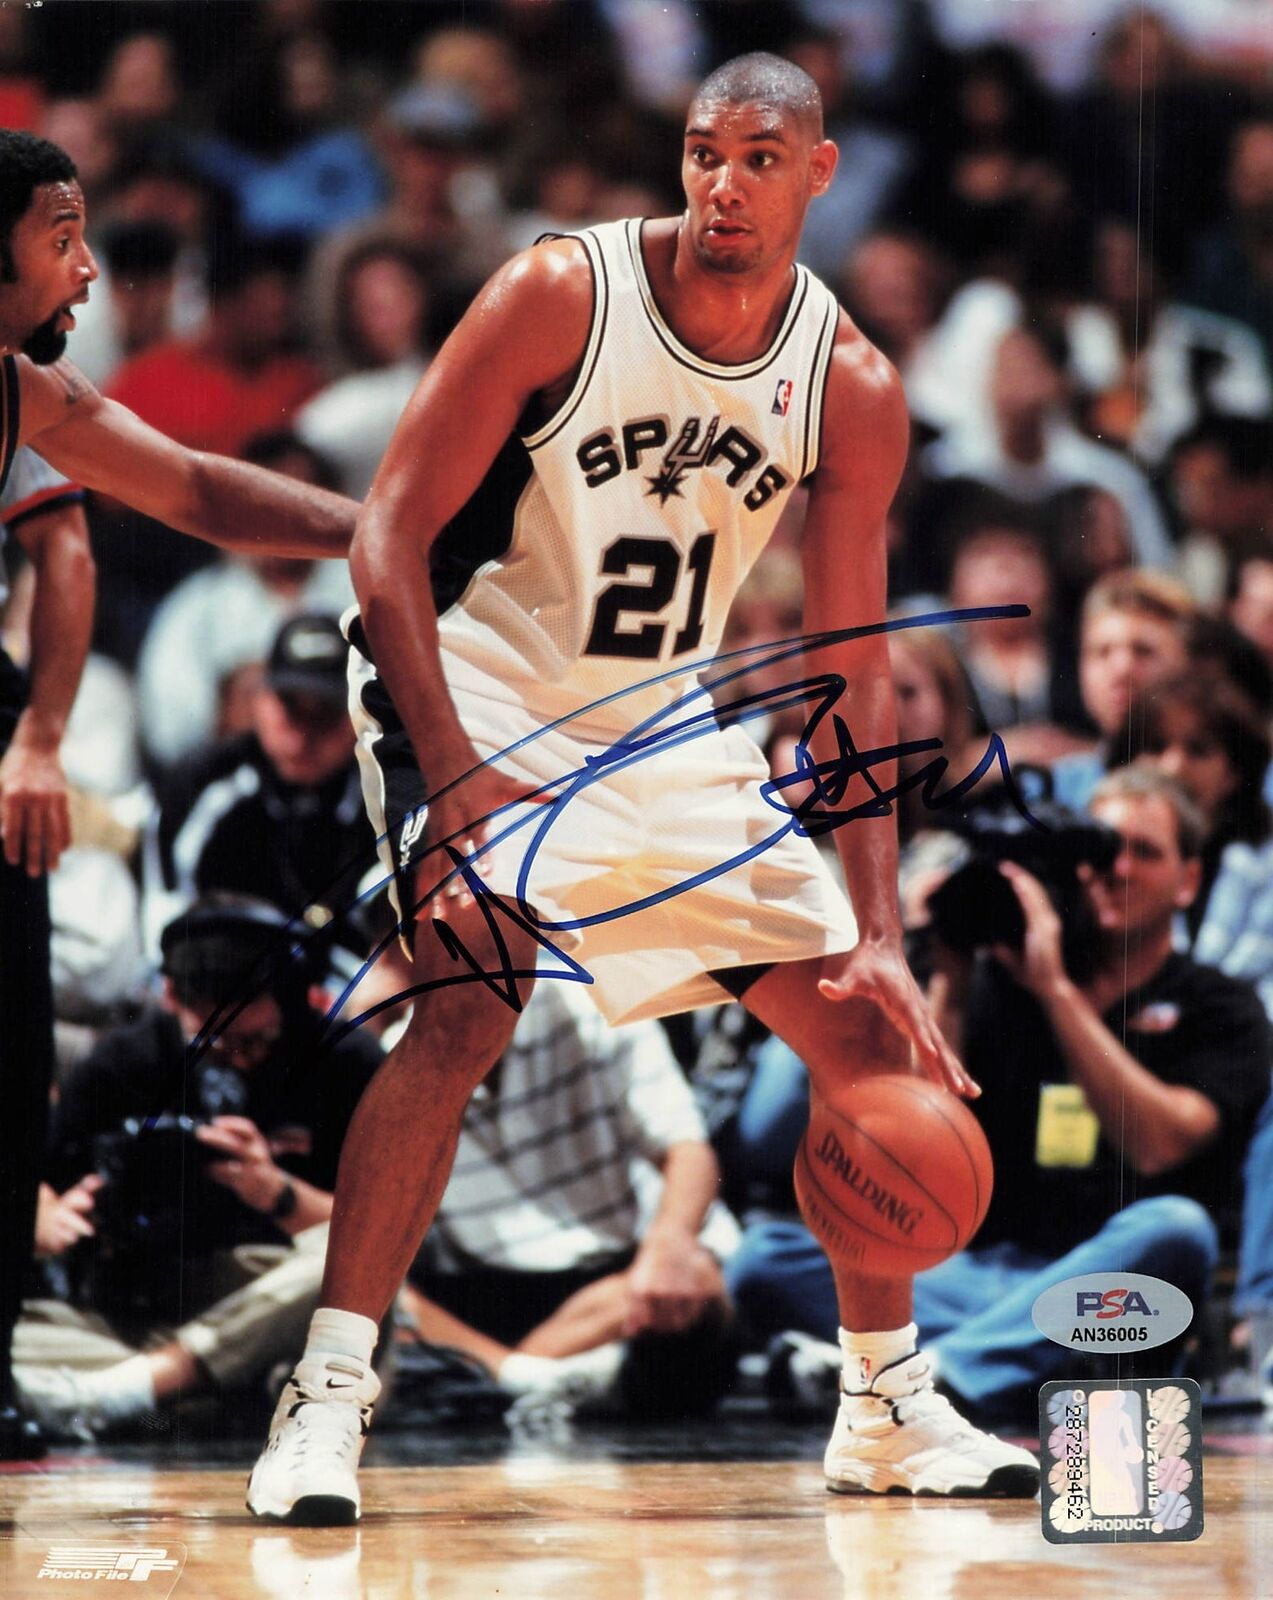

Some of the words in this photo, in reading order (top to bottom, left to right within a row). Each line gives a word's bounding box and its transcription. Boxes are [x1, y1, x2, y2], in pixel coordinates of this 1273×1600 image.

[576, 412, 796, 512] SPURS
[579, 529, 719, 663] 21
[815, 1129, 925, 1236] SPALDING
